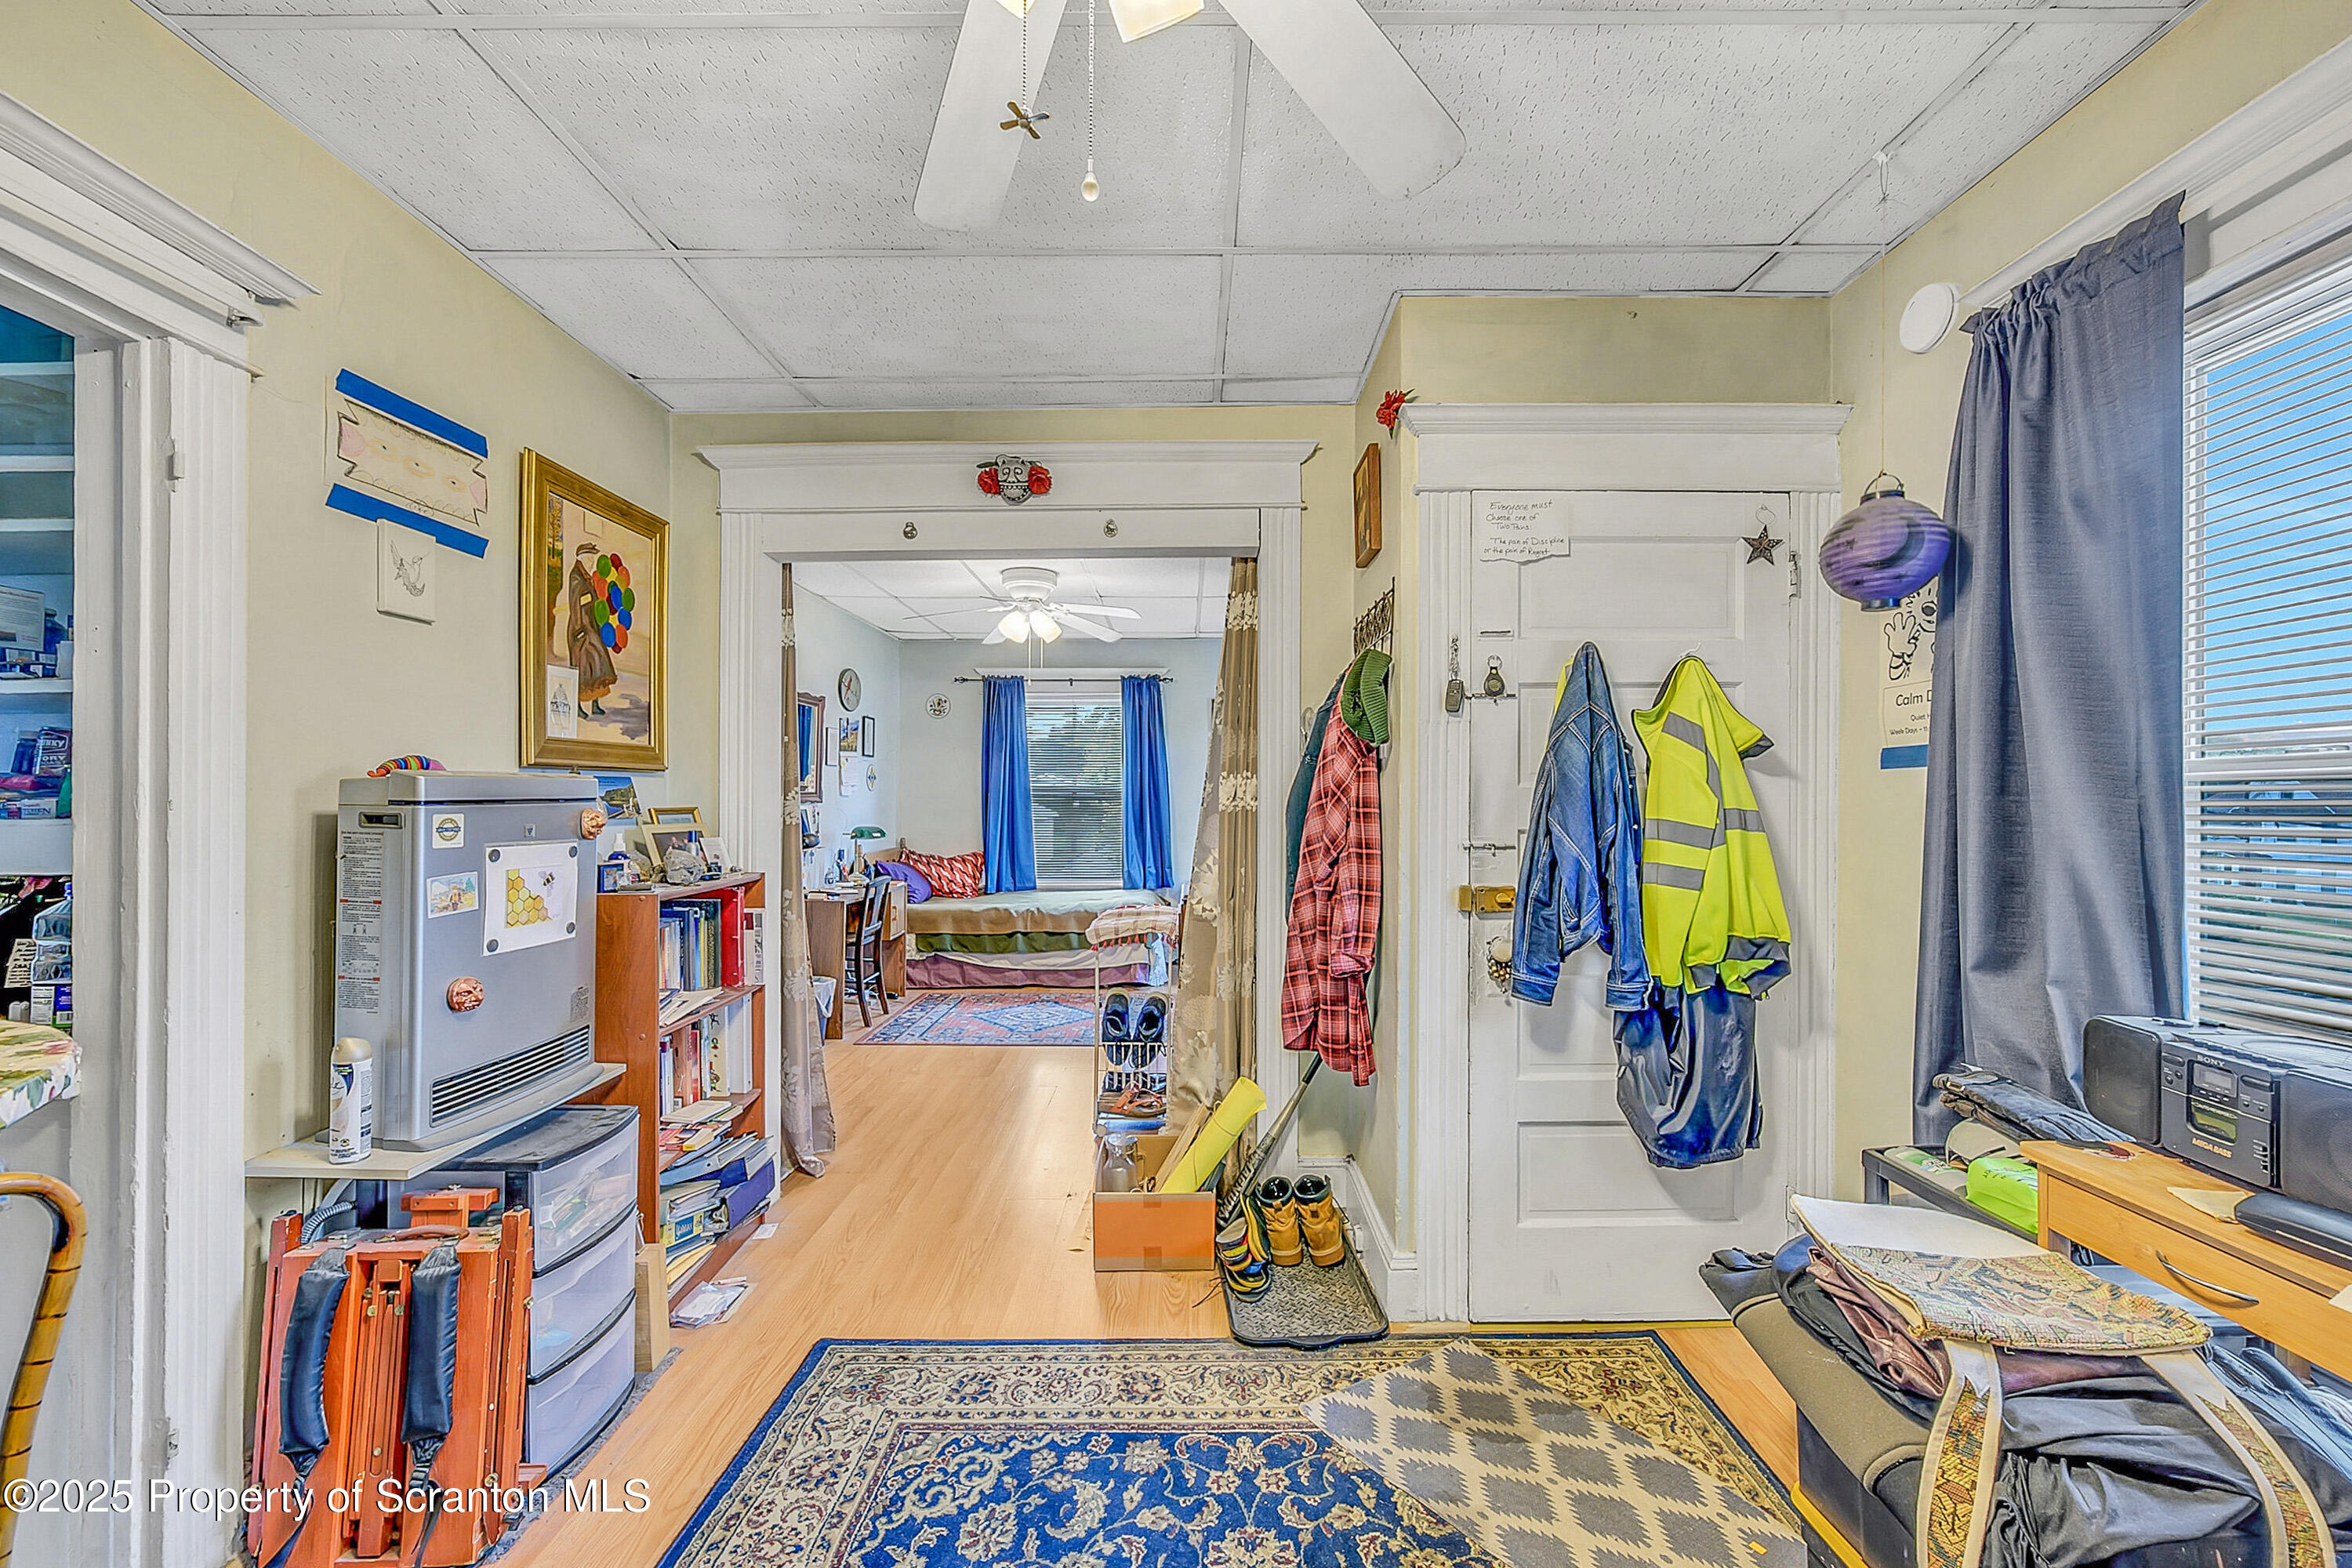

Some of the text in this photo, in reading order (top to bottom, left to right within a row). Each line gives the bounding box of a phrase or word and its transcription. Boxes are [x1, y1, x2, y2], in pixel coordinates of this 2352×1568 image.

[1490, 499, 1553, 515] Everyone must
[1486, 513, 1511, 521] Choose
[1529, 513, 1539, 521] of
[1530, 537, 1564, 546] Discipline
[1527, 547, 1551, 557] Regret
[1896, 692, 1923, 706] Calm
[2197, 1054, 2226, 1067] SONY
[2192, 1137, 2233, 1159] MEGA BASS
